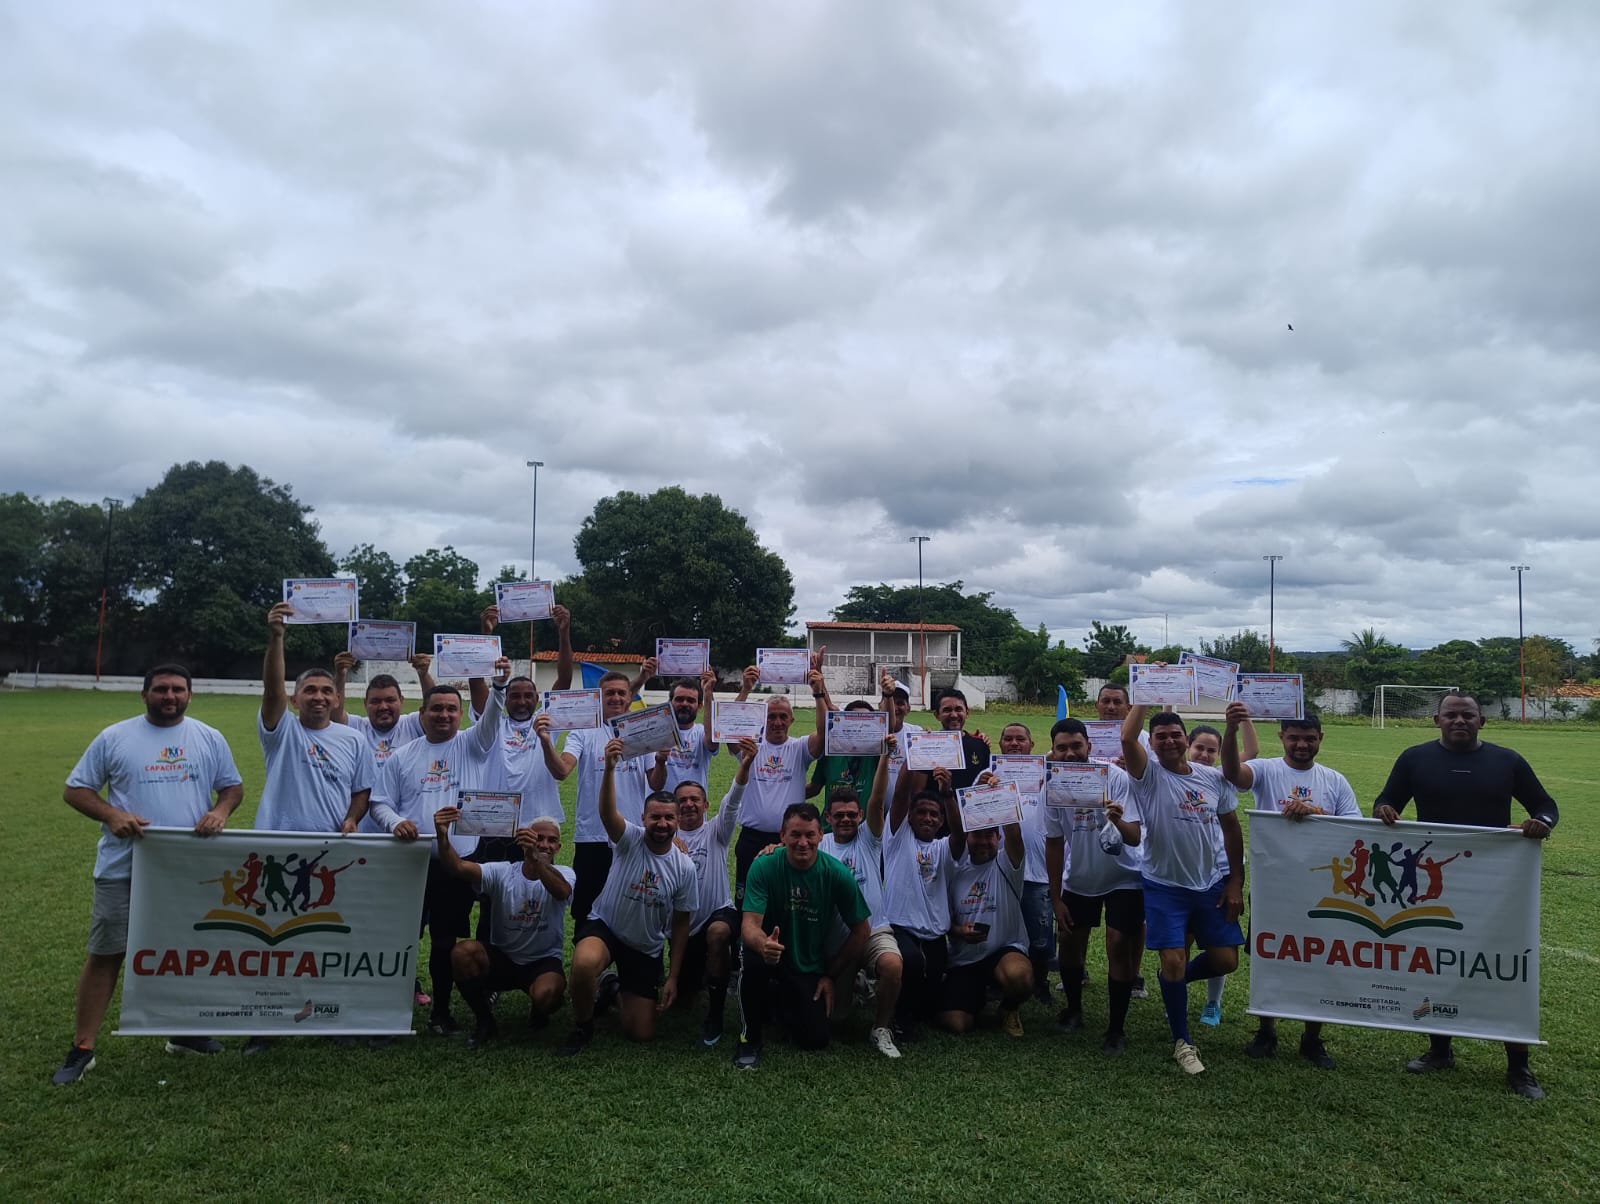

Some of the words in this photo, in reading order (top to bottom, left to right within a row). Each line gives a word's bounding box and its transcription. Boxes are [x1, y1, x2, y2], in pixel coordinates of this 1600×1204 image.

[133, 945, 412, 977] CAPACITAPIAUÍ
[1256, 932, 1532, 982] CAPACITAPIAUÍ
[1335, 1000, 1372, 1009] ESPORTES
[1359, 996, 1400, 1005] SECRETARIA
